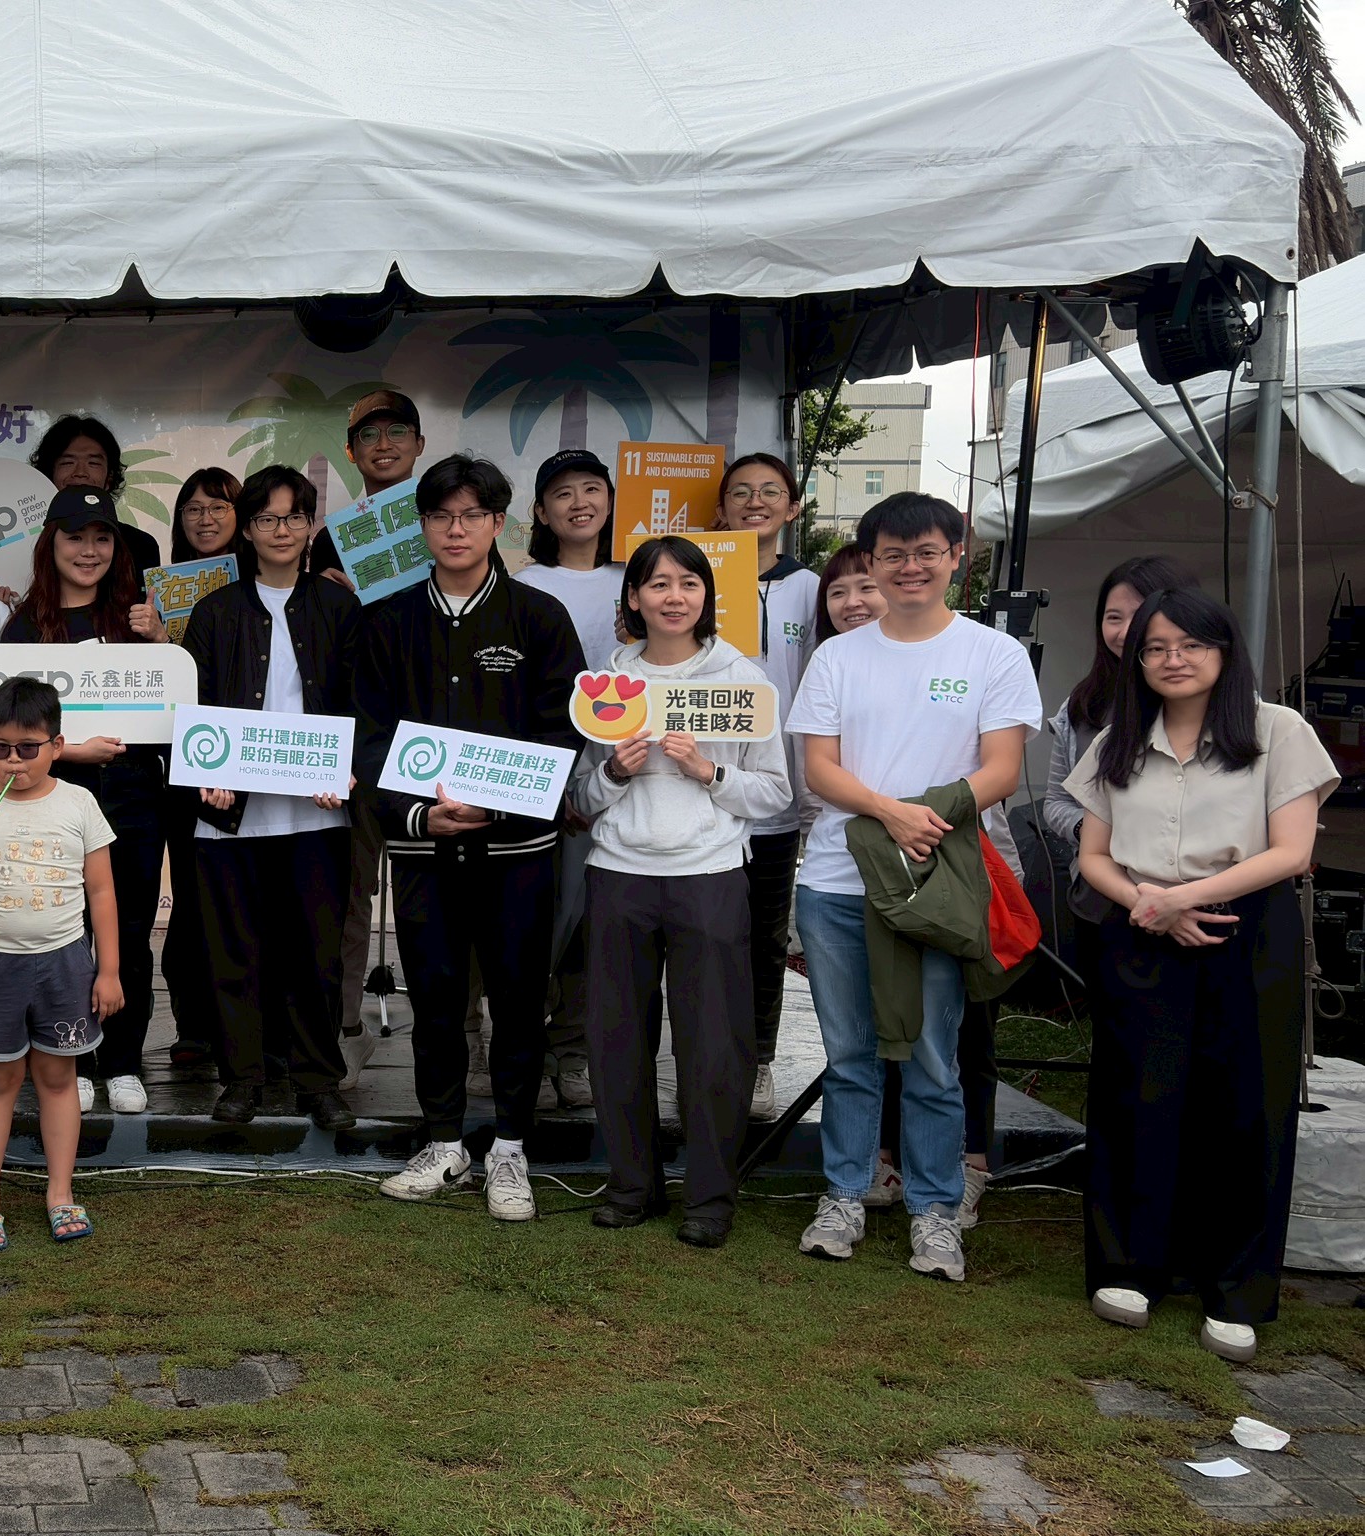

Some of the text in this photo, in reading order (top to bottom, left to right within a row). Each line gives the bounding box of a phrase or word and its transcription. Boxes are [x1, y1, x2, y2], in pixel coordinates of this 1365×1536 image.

[624, 451, 716, 476] 11 SUSTAINABLE CITIES
[645, 466, 711, 479] AND COMMUNITIES
[17, 494, 36, 507] new
[20, 500, 47, 517] green
[23, 510, 47, 526] powe
[716, 541, 736, 553] AND
[79, 669, 164, 688] 永鑫能源
[929, 678, 969, 694] ESG
[79, 690, 165, 700] new green power
[665, 688, 755, 709] 光電回收
[944, 694, 964, 704] TCC
[665, 712, 754, 733] 最佳隊友
[241, 726, 339, 750] 鴻升環境科技
[240, 745, 338, 769] 股份有限公司
[458, 743, 558, 774] 鴻升環境科技
[239, 766, 270, 776] HORNG
[271, 769, 301, 779] SHENG
[452, 761, 552, 793] 股份有限公司
[447, 781, 479, 793] HORNG
[479, 786, 510, 799] SHENG
